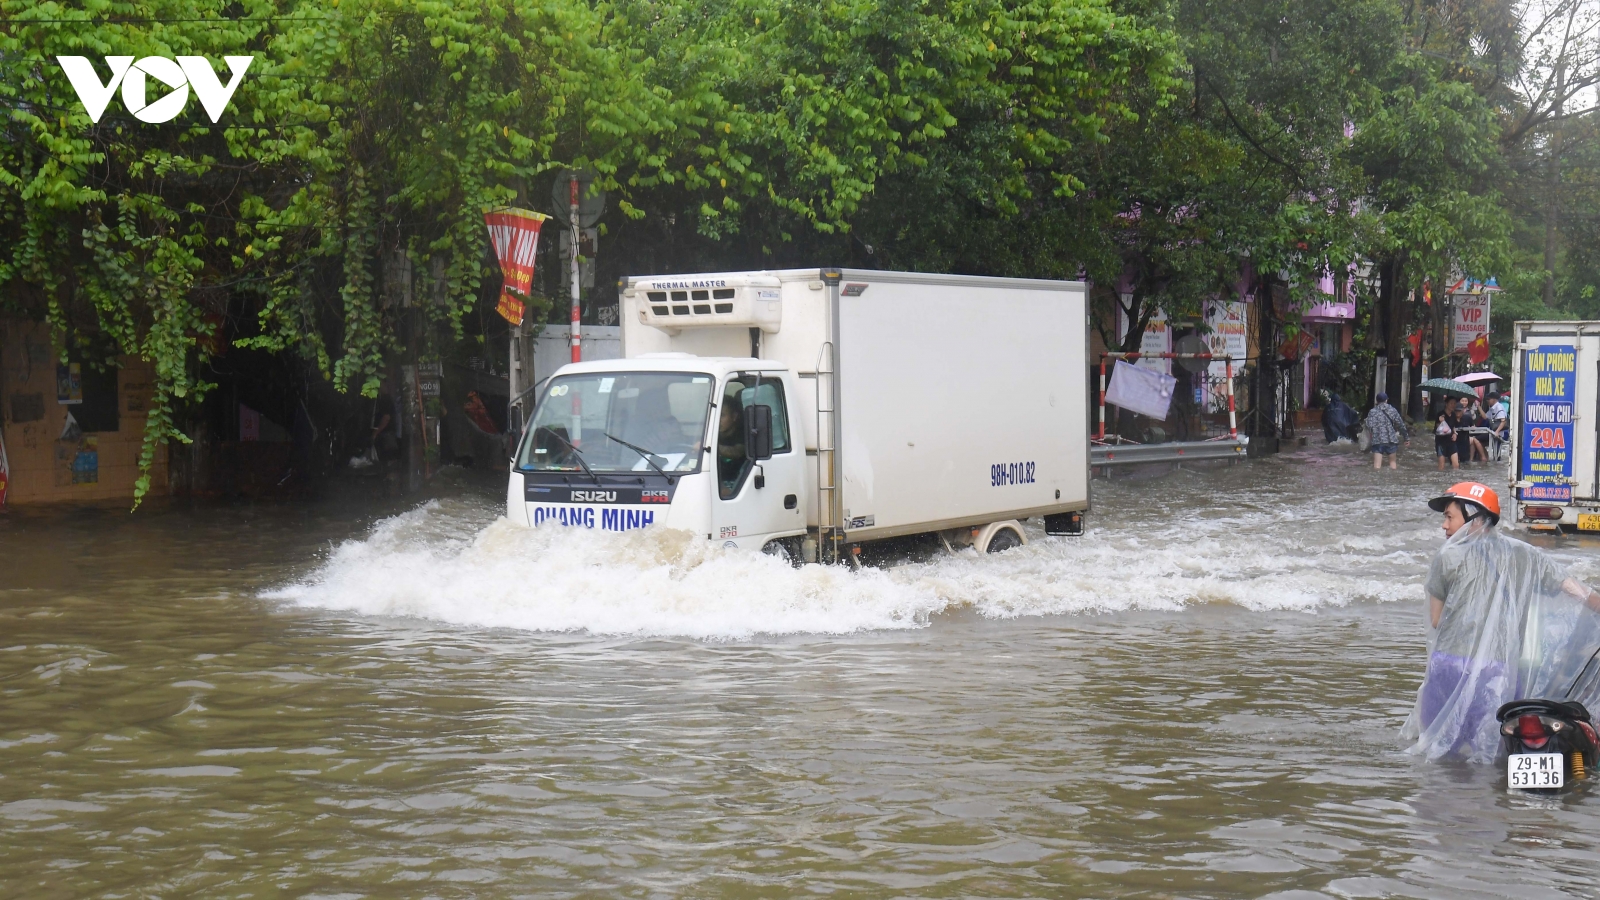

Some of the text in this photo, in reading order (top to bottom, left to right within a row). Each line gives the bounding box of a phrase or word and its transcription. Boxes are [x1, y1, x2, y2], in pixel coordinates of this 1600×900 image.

[692, 280, 726, 288] MASTER
[1461, 308, 1482, 322] VIP
[1456, 324, 1486, 332] MASSAGE
[1528, 348, 1574, 372] VĂN PHÒNG
[1535, 373, 1565, 396] NHÀ XE
[1556, 405, 1571, 422] CHI
[1530, 427, 1565, 448] 29A
[1546, 450, 1557, 460] THỦ
[991, 461, 1036, 487] 98H-010.82
[1531, 463, 1564, 472] HOÀNG LIỆT
[571, 490, 617, 502] ISUZU
[601, 508, 654, 532] MINH
[720, 531, 738, 539] 270
[1517, 756, 1554, 770] 29-M1
[1512, 771, 1559, 785] 531.36
